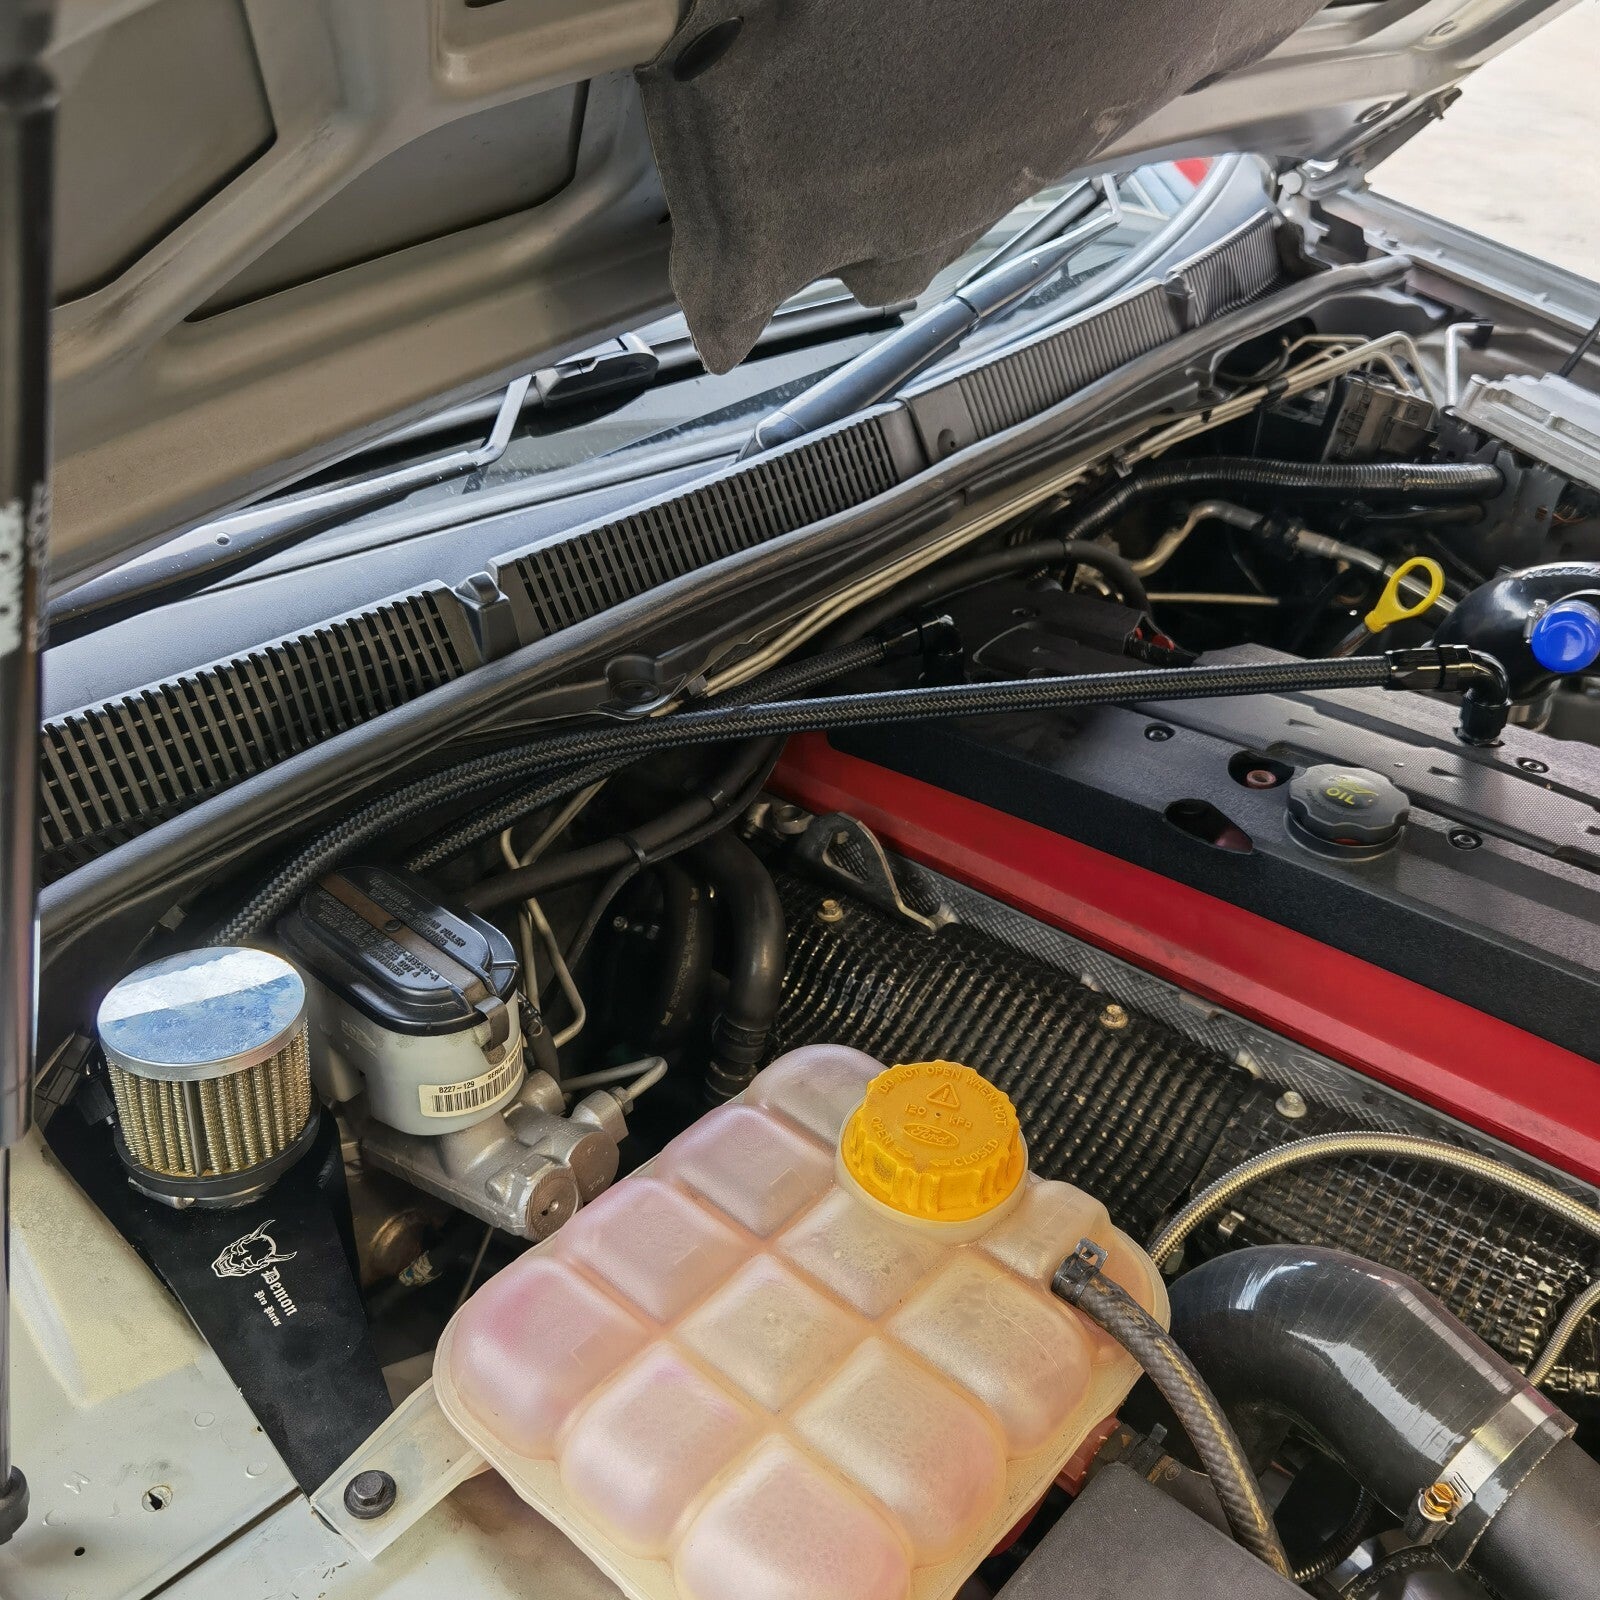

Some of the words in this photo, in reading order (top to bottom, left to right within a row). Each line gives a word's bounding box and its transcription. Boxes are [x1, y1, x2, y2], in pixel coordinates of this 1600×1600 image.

[1326, 788, 1355, 805] OIL
[440, 927, 466, 948] FILLER
[880, 1079, 895, 1094] DO
[898, 1067, 921, 1080] NOT
[926, 1066, 962, 1080] OPEN
[966, 1075, 998, 1101] WHEN
[993, 1100, 1007, 1126] HOT
[871, 1116, 894, 1145] OPEN
[904, 1103, 927, 1116] 120
[949, 1114, 972, 1129] kPa
[911, 1126, 949, 1145] Ford
[953, 1138, 999, 1167] CLOSED
[261, 1266, 297, 1316] Demon
[254, 1290, 267, 1305] Pro
[264, 1305, 281, 1326] Parts
